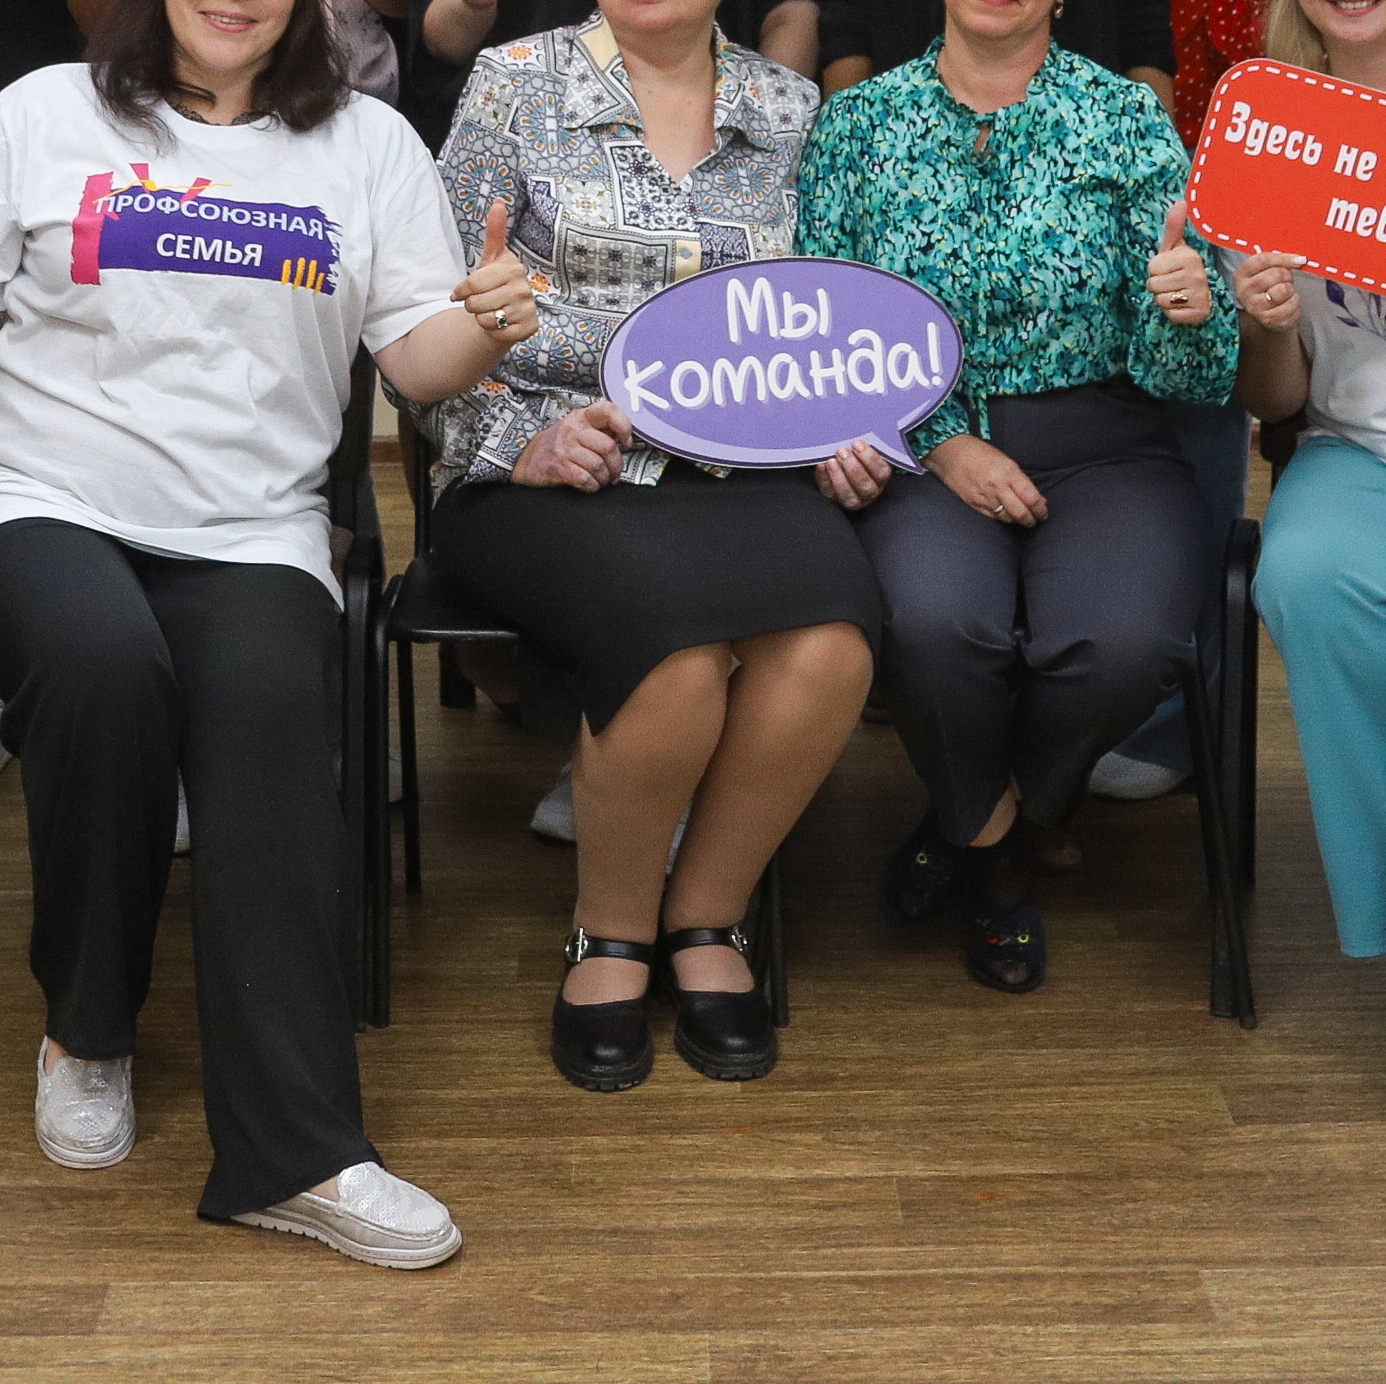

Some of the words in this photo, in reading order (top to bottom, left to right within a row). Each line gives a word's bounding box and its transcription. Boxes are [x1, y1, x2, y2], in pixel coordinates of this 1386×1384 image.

[1224, 100, 1324, 166] Здесь
[1334, 143, 1378, 182] не
[95, 192, 324, 241] ПРОФСОЮЗНАЯ
[156, 232, 263, 267] СЕМЬЯ
[727, 276, 831, 343] Мы
